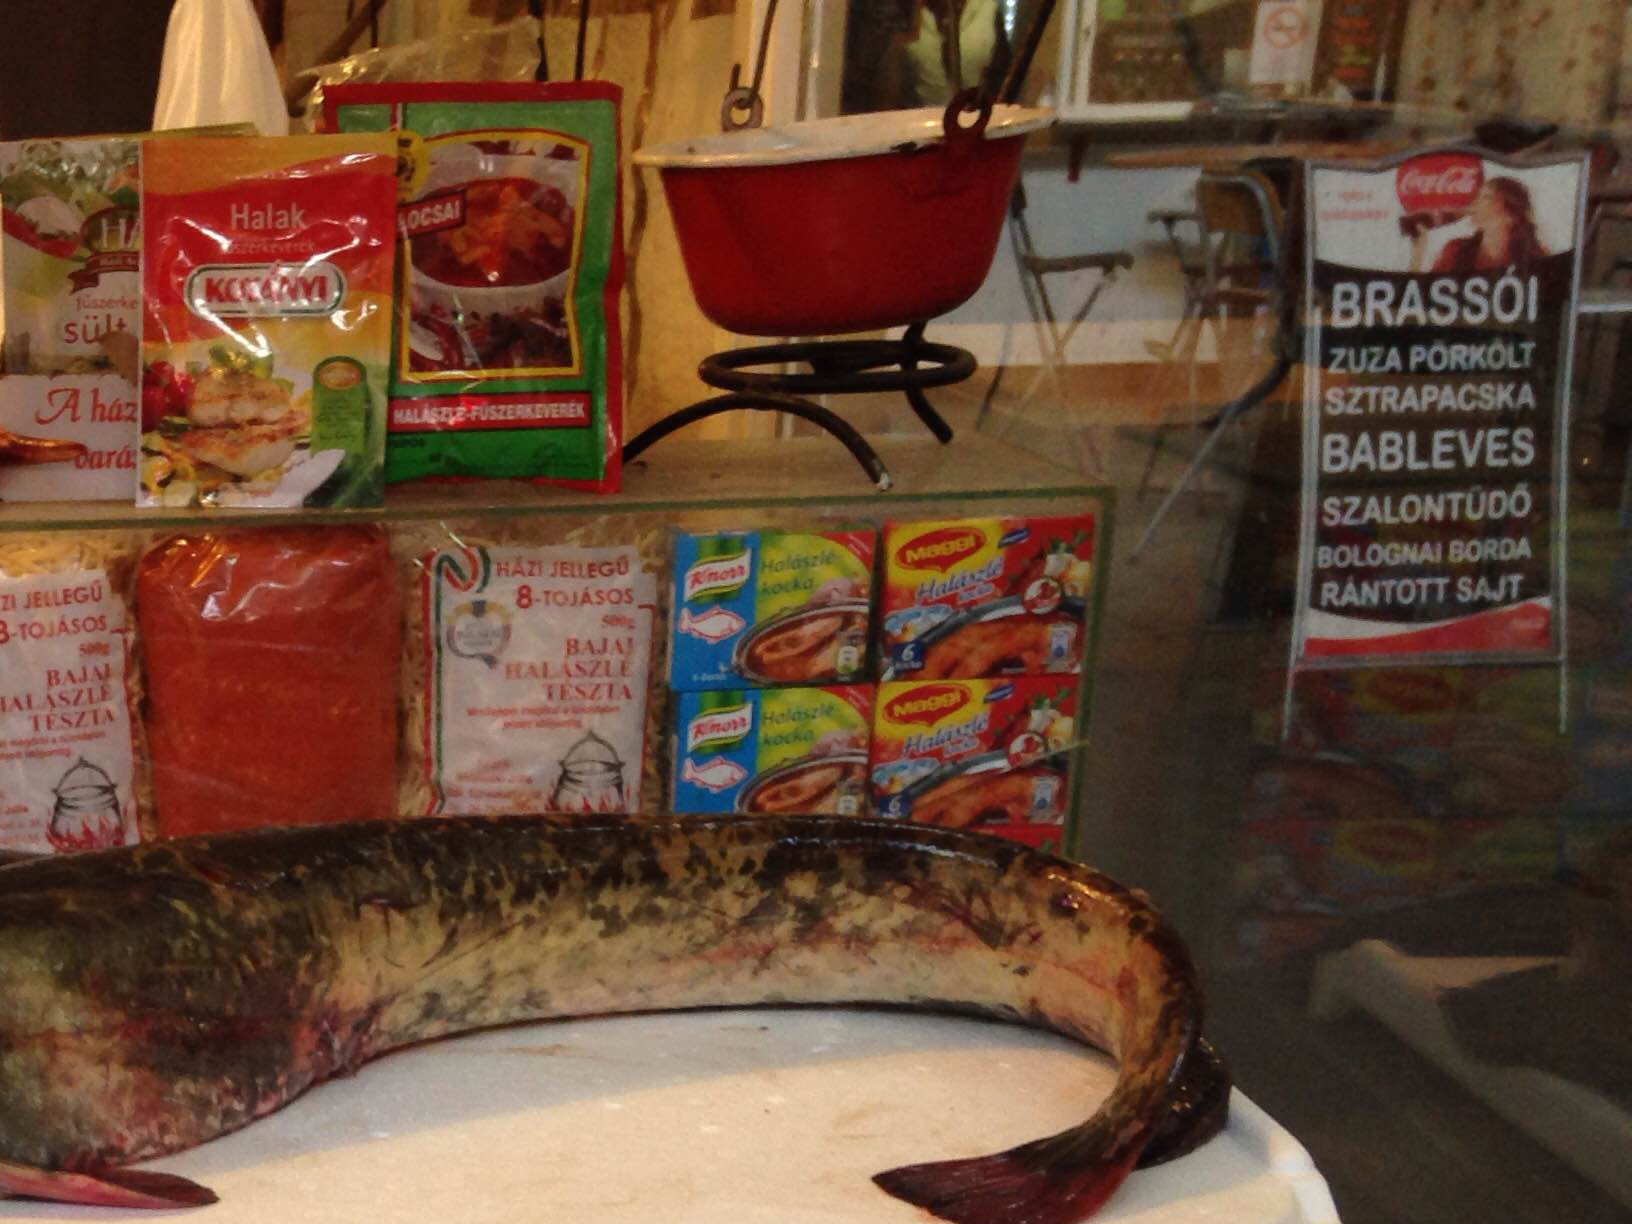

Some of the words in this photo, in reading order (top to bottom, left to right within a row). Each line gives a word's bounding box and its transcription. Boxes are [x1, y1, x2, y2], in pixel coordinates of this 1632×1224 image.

[230, 203, 306, 229] Halak
[1331, 266, 1539, 329] BRASSÓI
[1409, 340, 1536, 371] PÖRKÖLT
[35, 387, 82, 425] A
[1324, 382, 1537, 416] SZTRAPACSKA
[1321, 428, 1536, 474] BABLEVES
[496, 557, 544, 578] HÁZI
[1317, 543, 1443, 569] BOLOGNAI
[1449, 538, 1532, 564] BORDA
[688, 562, 746, 587] Knorr
[22, 580, 103, 610] JELLEGŰ
[516, 584, 635, 609] 8-TOJÁSOS
[1320, 576, 1449, 608] RÁNTOTT
[1456, 573, 1525, 602] SAJT
[900, 642, 916, 662] 6
[692, 714, 748, 740] Knorr
